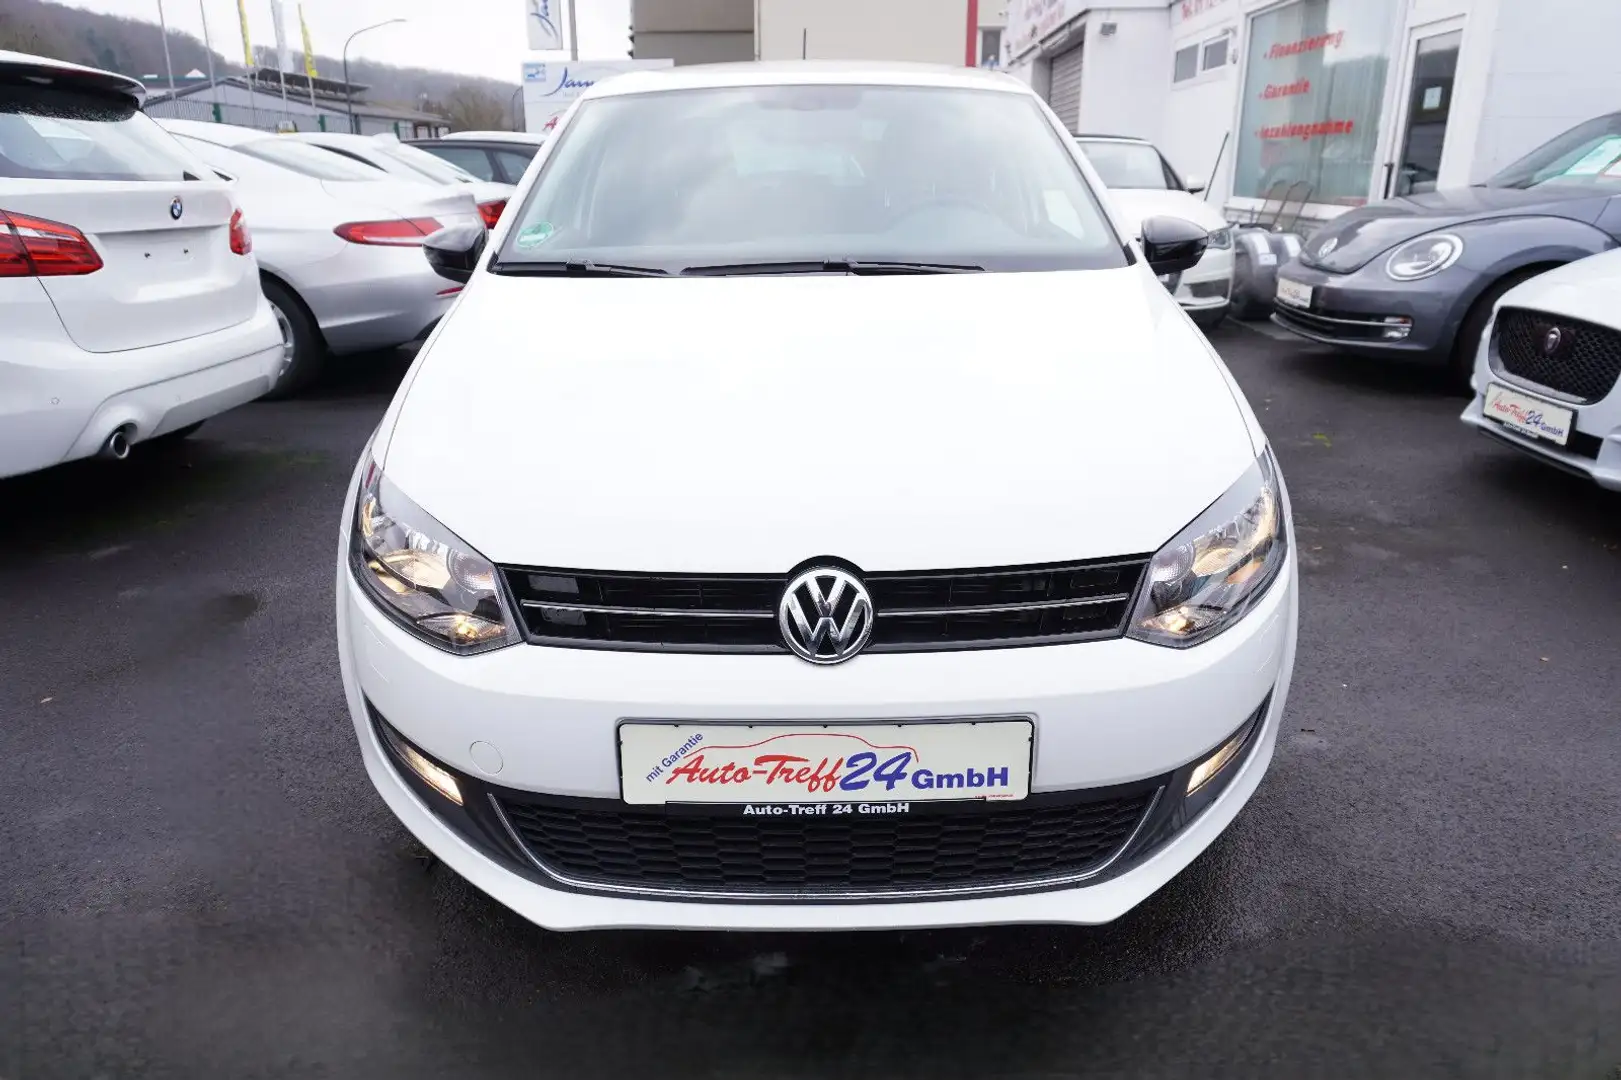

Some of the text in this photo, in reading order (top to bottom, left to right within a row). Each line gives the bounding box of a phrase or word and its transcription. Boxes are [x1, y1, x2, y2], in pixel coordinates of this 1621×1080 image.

[645, 732, 704, 783] mit Garantie
[911, 766, 1009, 790] GmbH
[742, 802, 910, 815] Auto-Treff 24 GmbH
